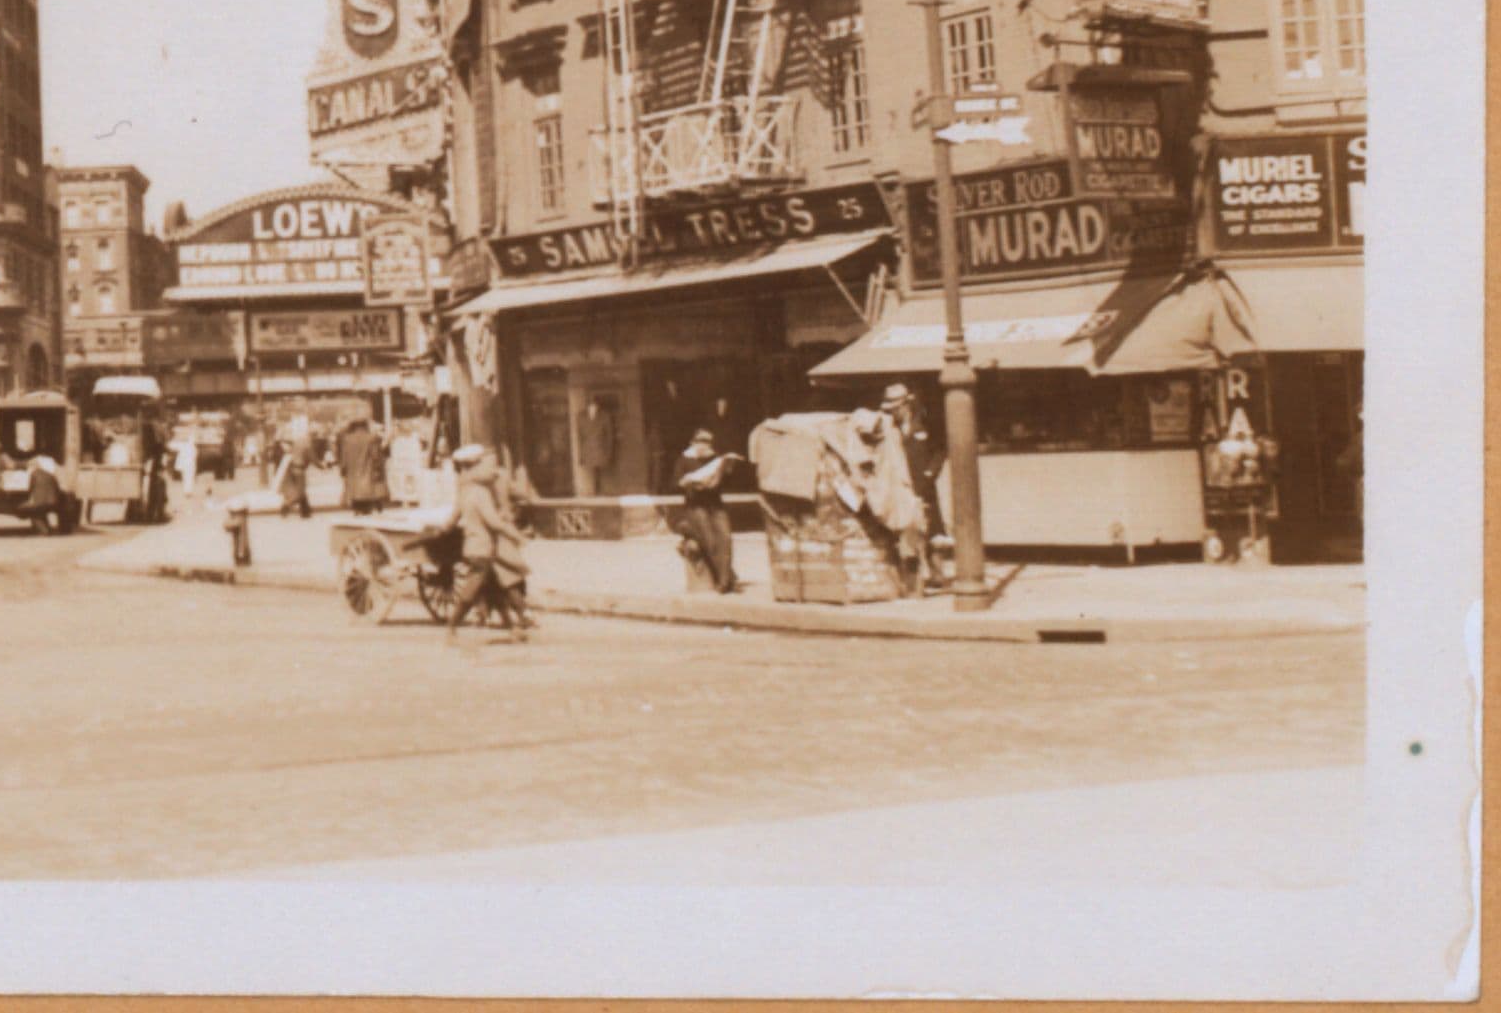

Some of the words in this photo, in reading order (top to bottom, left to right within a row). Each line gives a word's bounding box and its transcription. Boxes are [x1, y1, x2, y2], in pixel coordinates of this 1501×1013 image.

[311, 78, 401, 132] CANAL
[1076, 126, 1161, 158] MURAD
[1219, 154, 1322, 185] MURIEL
[1222, 182, 1320, 206] CIGARS
[684, 196, 814, 248] TRESS
[838, 197, 864, 220] 25
[969, 205, 1105, 266] MURAD
